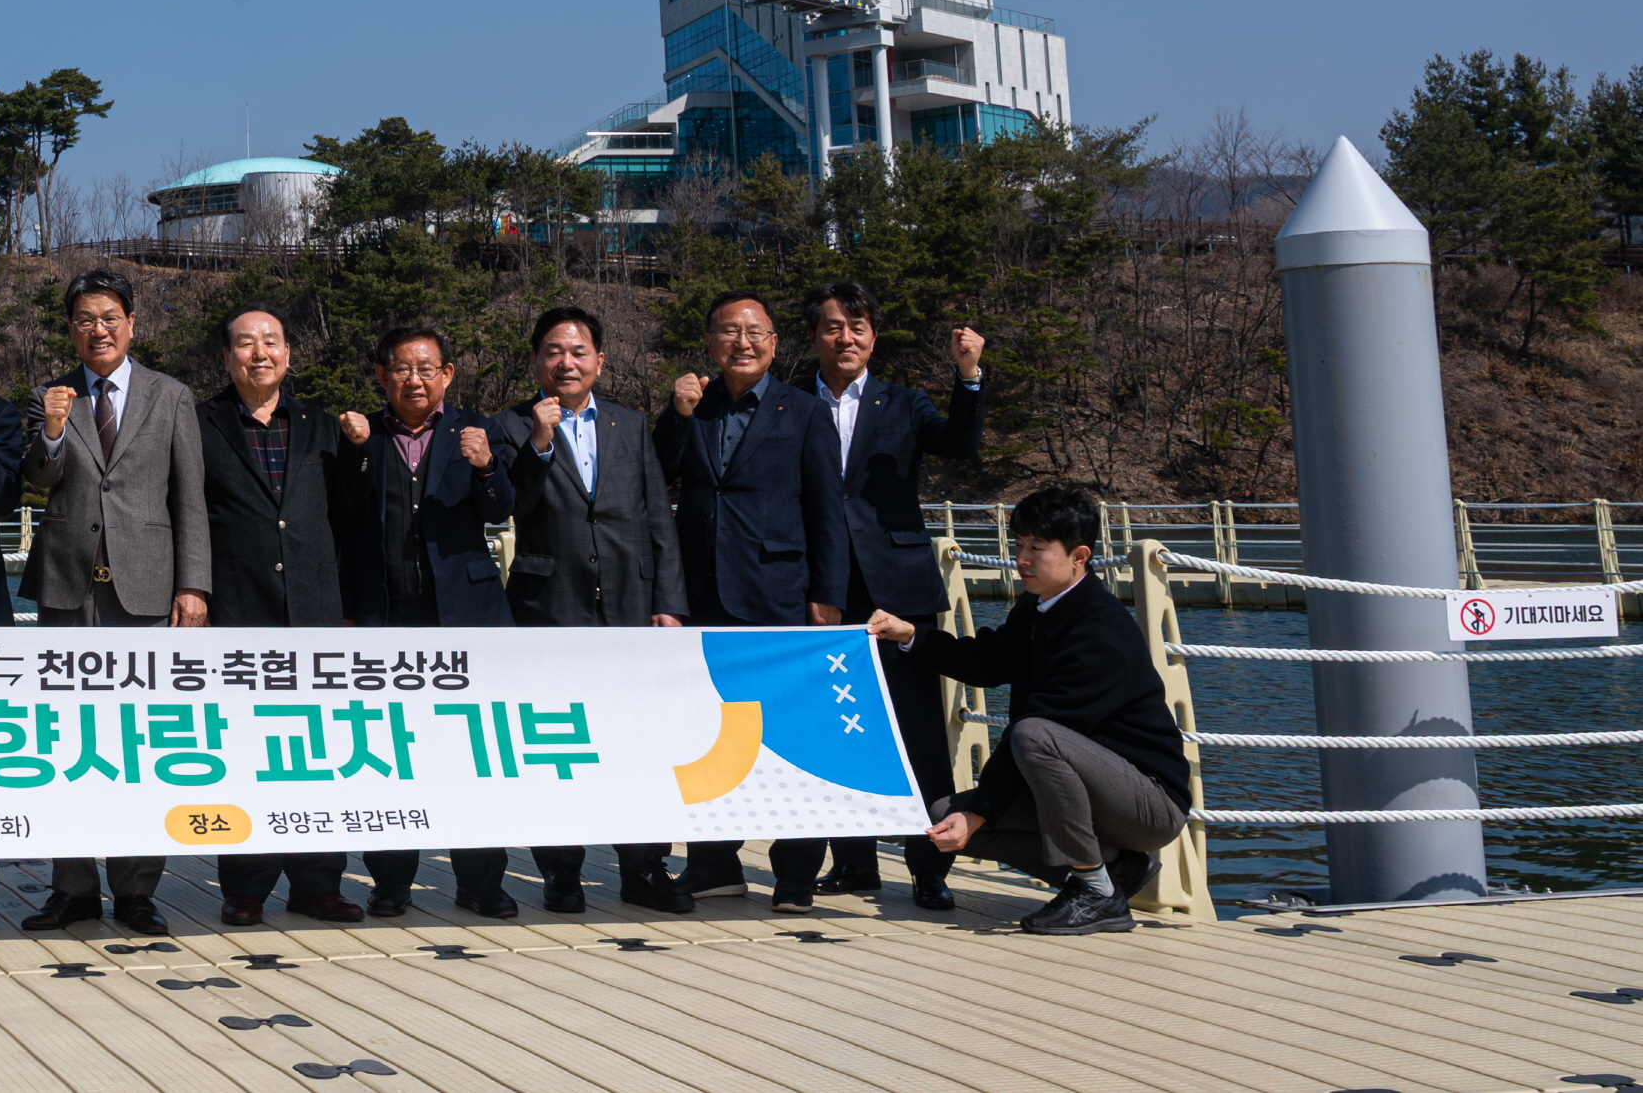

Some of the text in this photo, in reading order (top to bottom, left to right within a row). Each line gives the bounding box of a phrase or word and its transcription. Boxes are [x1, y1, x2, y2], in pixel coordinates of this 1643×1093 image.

[1504, 605, 1604, 624] 기대지마세요
[37, 650, 157, 690] 천안시
[312, 651, 469, 691] 도농상생
[254, 701, 415, 781] 교차
[434, 702, 599, 779] 기부
[189, 814, 232, 834] 장소
[267, 809, 429, 834] 청양군 칠갑타워
